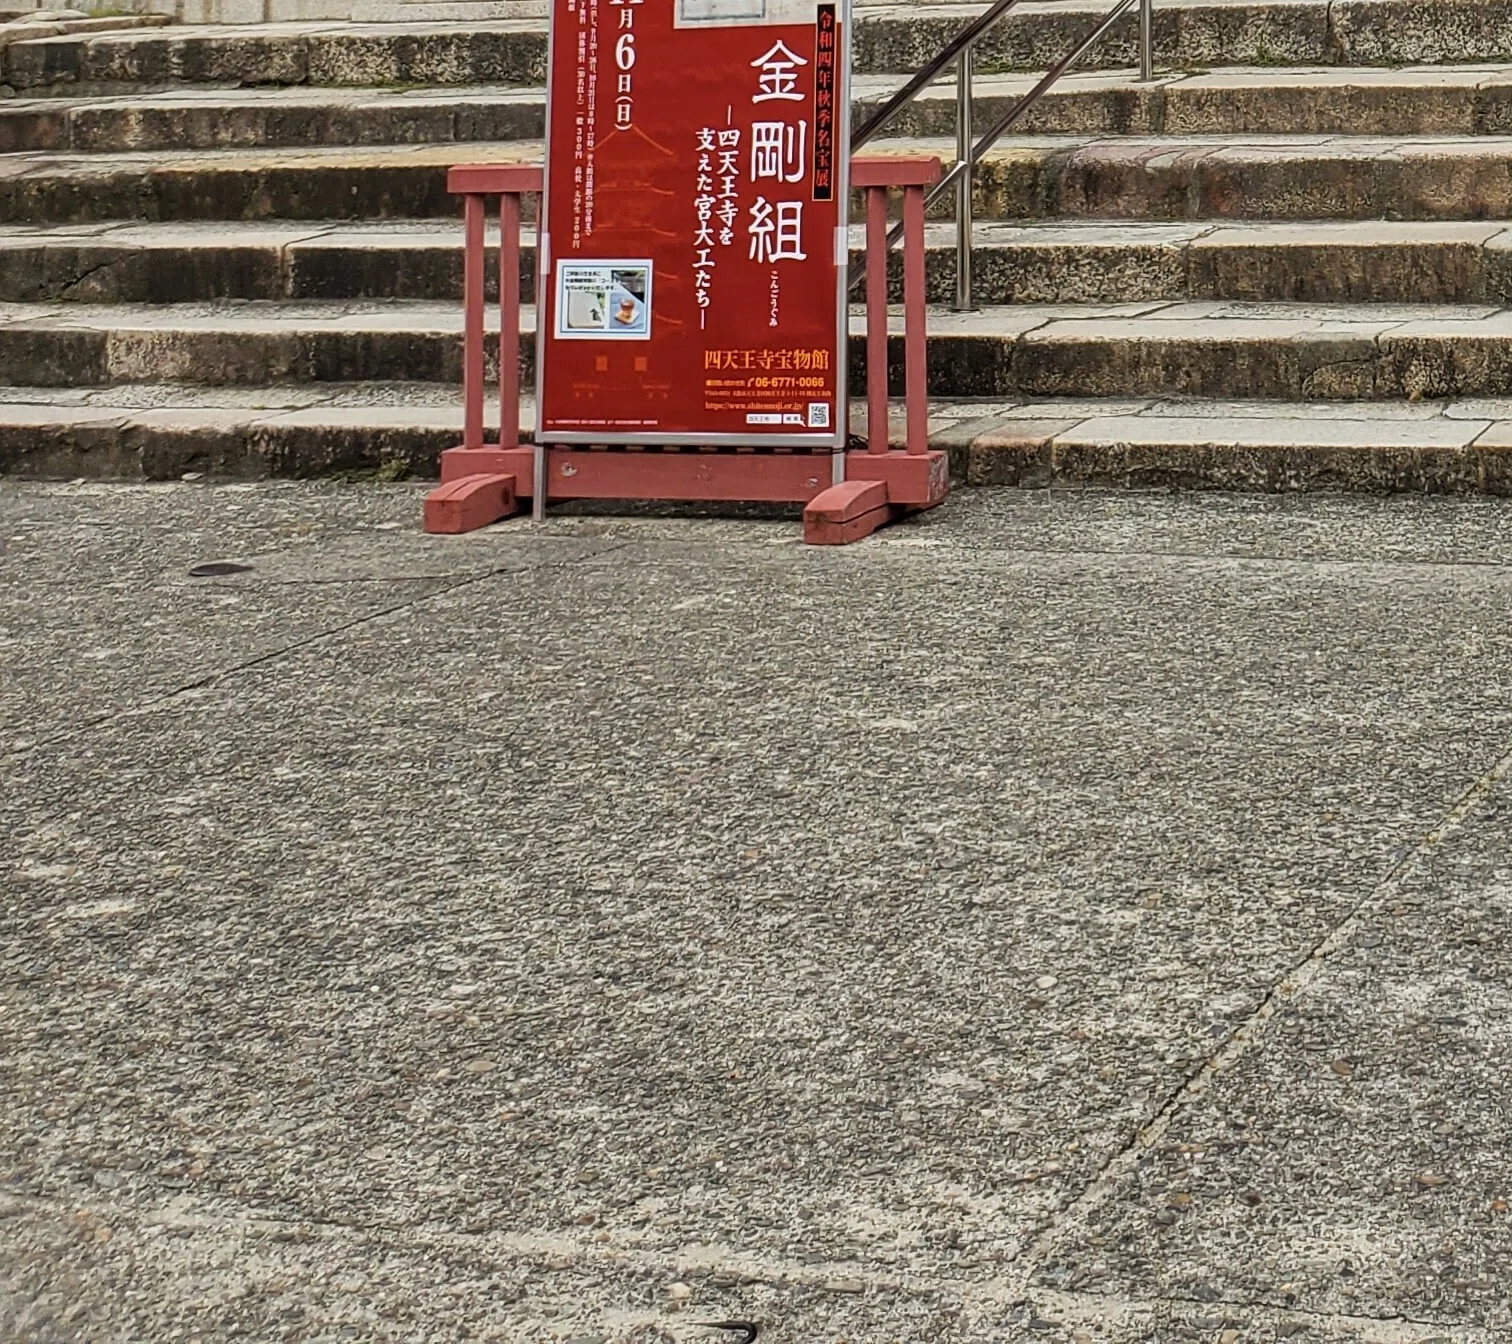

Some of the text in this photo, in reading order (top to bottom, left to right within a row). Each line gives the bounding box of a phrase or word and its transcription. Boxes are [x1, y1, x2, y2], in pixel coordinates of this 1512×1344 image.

[748, 39, 808, 263] 金剛組
[814, 11, 834, 188] 令和四年秋季名宝展
[767, 269, 781, 328] こんごうぐみ
[704, 348, 830, 370] 四天王寺宝物館
